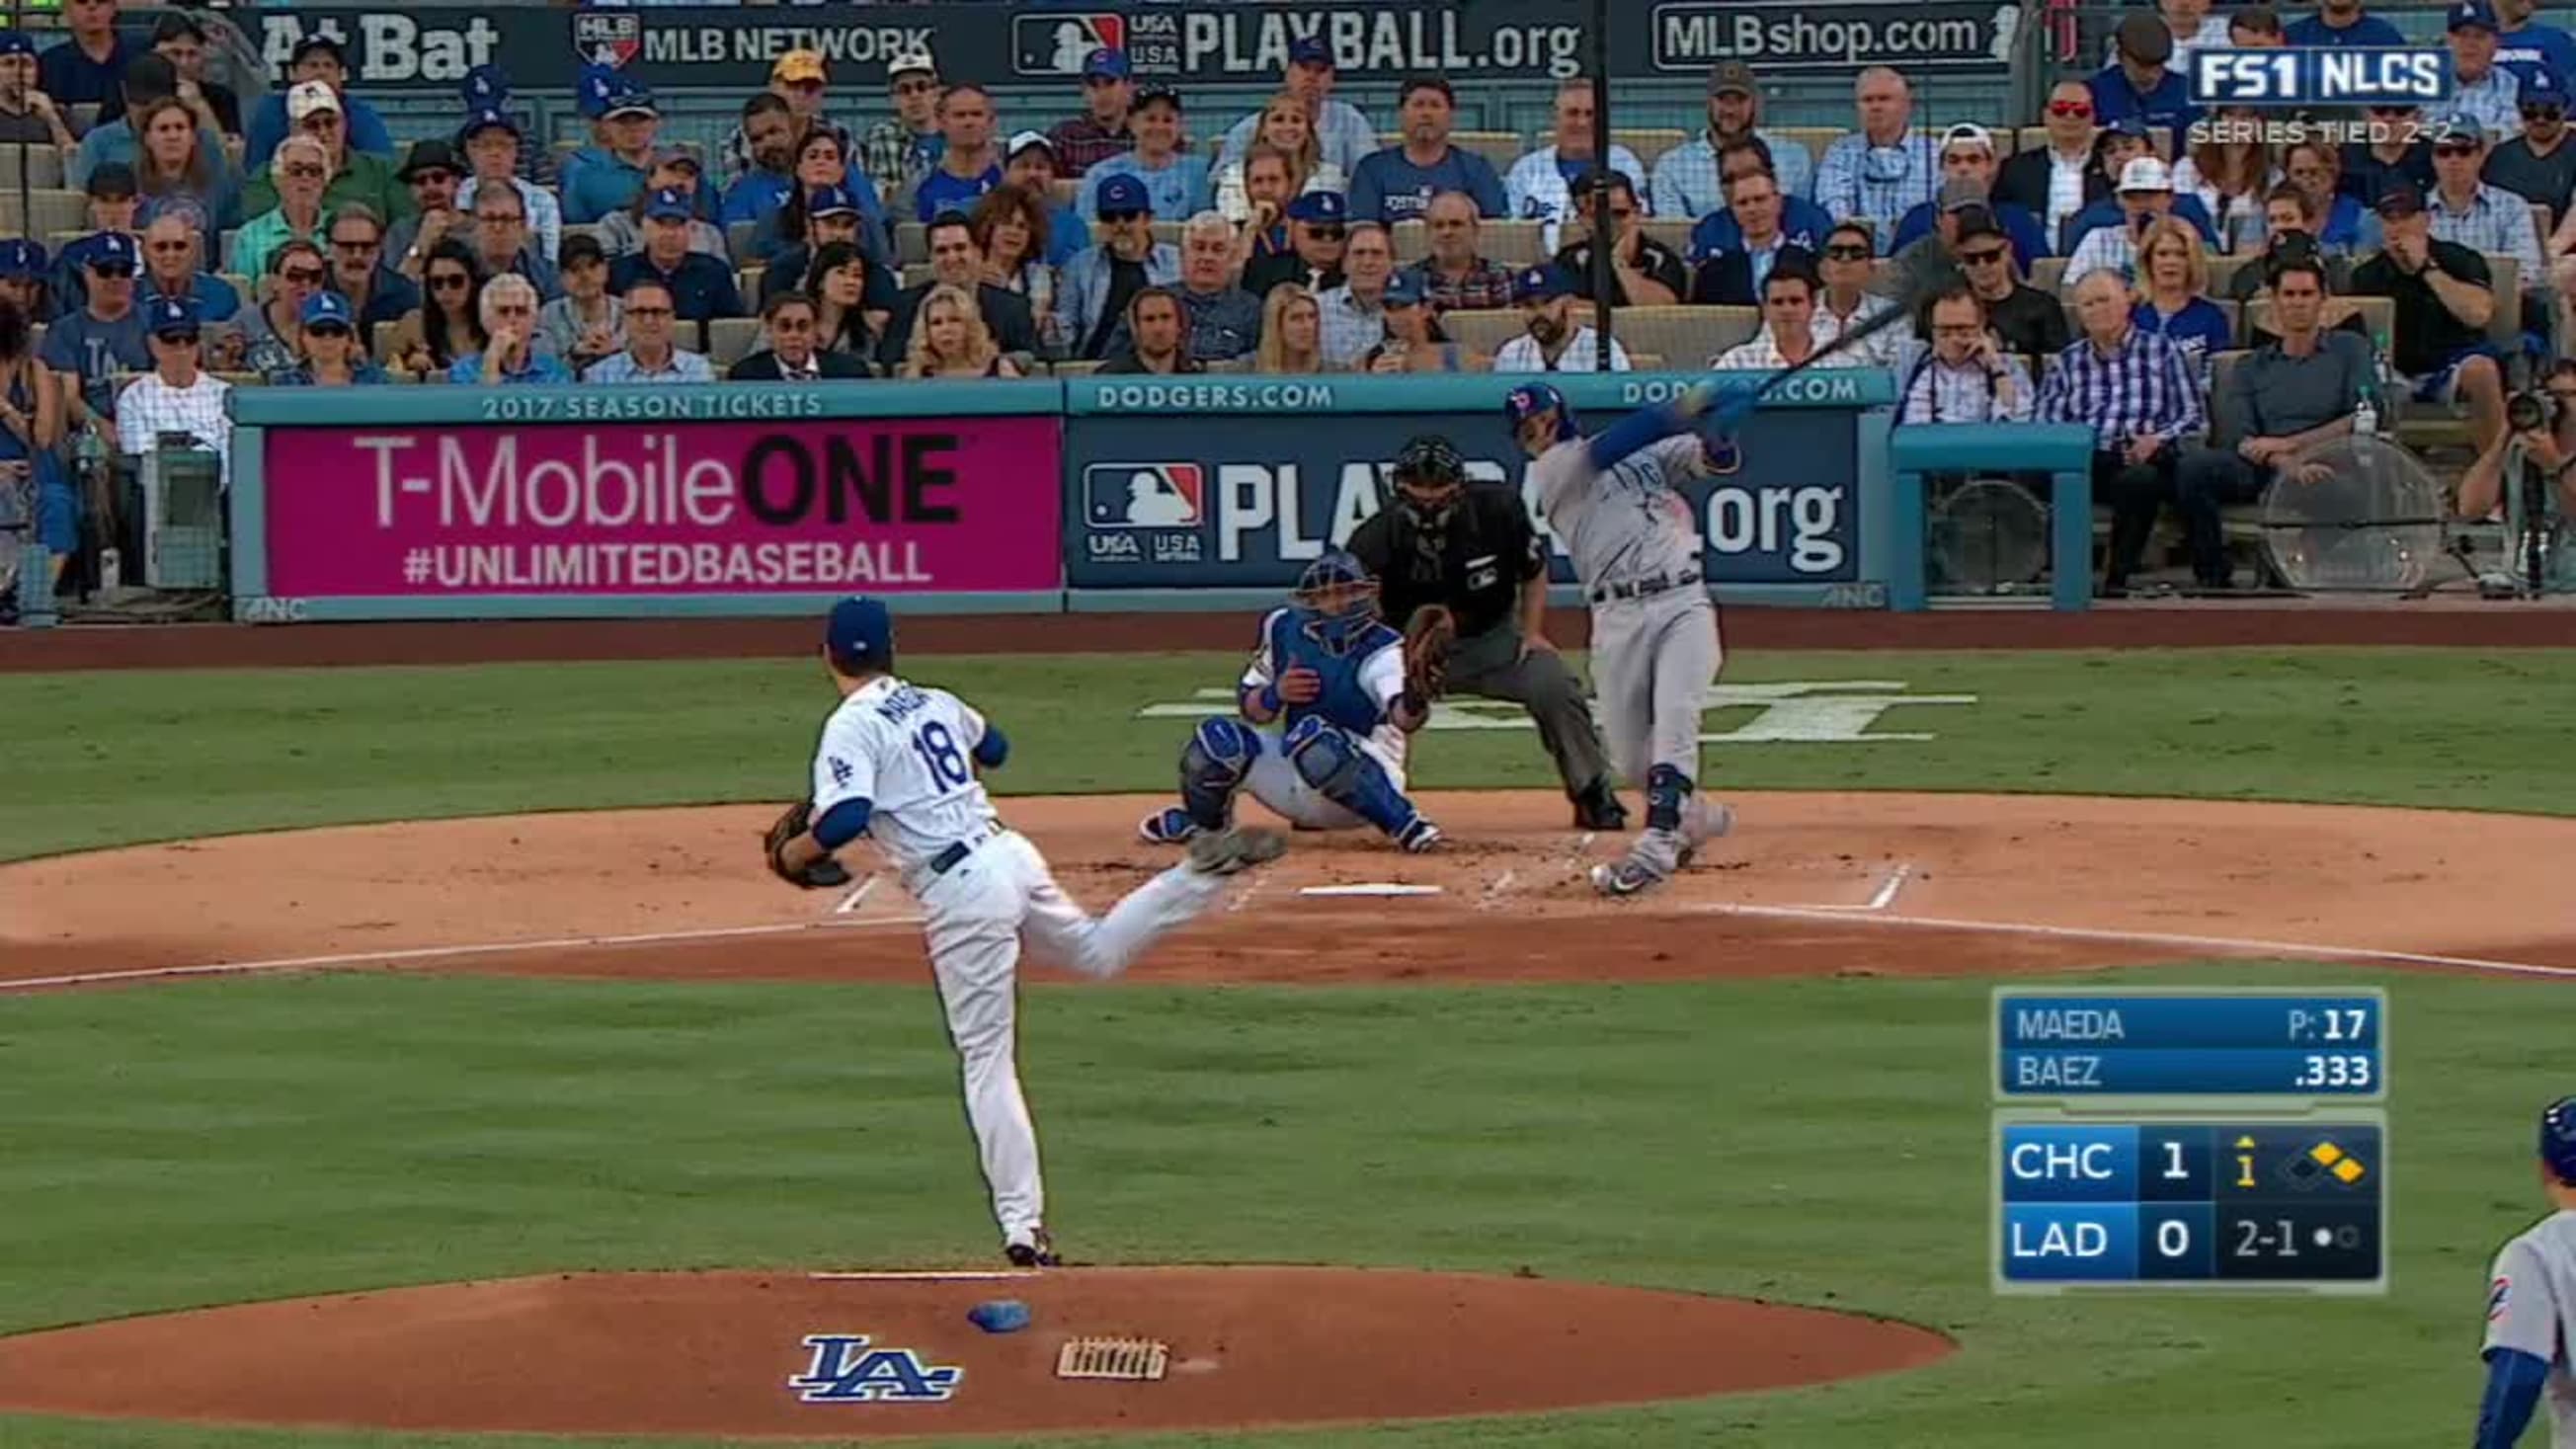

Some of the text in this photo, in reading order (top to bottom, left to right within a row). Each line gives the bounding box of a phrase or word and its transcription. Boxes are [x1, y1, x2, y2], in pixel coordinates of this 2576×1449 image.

[1129, 15, 1177, 34] USA
[1665, 14, 1975, 62] MLBshop.com
[359, 13, 500, 81] Bat
[644, 28, 935, 61] MLB NETWORK
[1130, 45, 1178, 63] USA
[481, 393, 822, 419] 2017 SEASON TICKETS
[1097, 384, 1332, 408] DODGERS.COM
[1154, 534, 1201, 552] USA
[402, 541, 932, 587] #UNLIMITEDBASEBALL
[911, 720, 967, 794] 18
